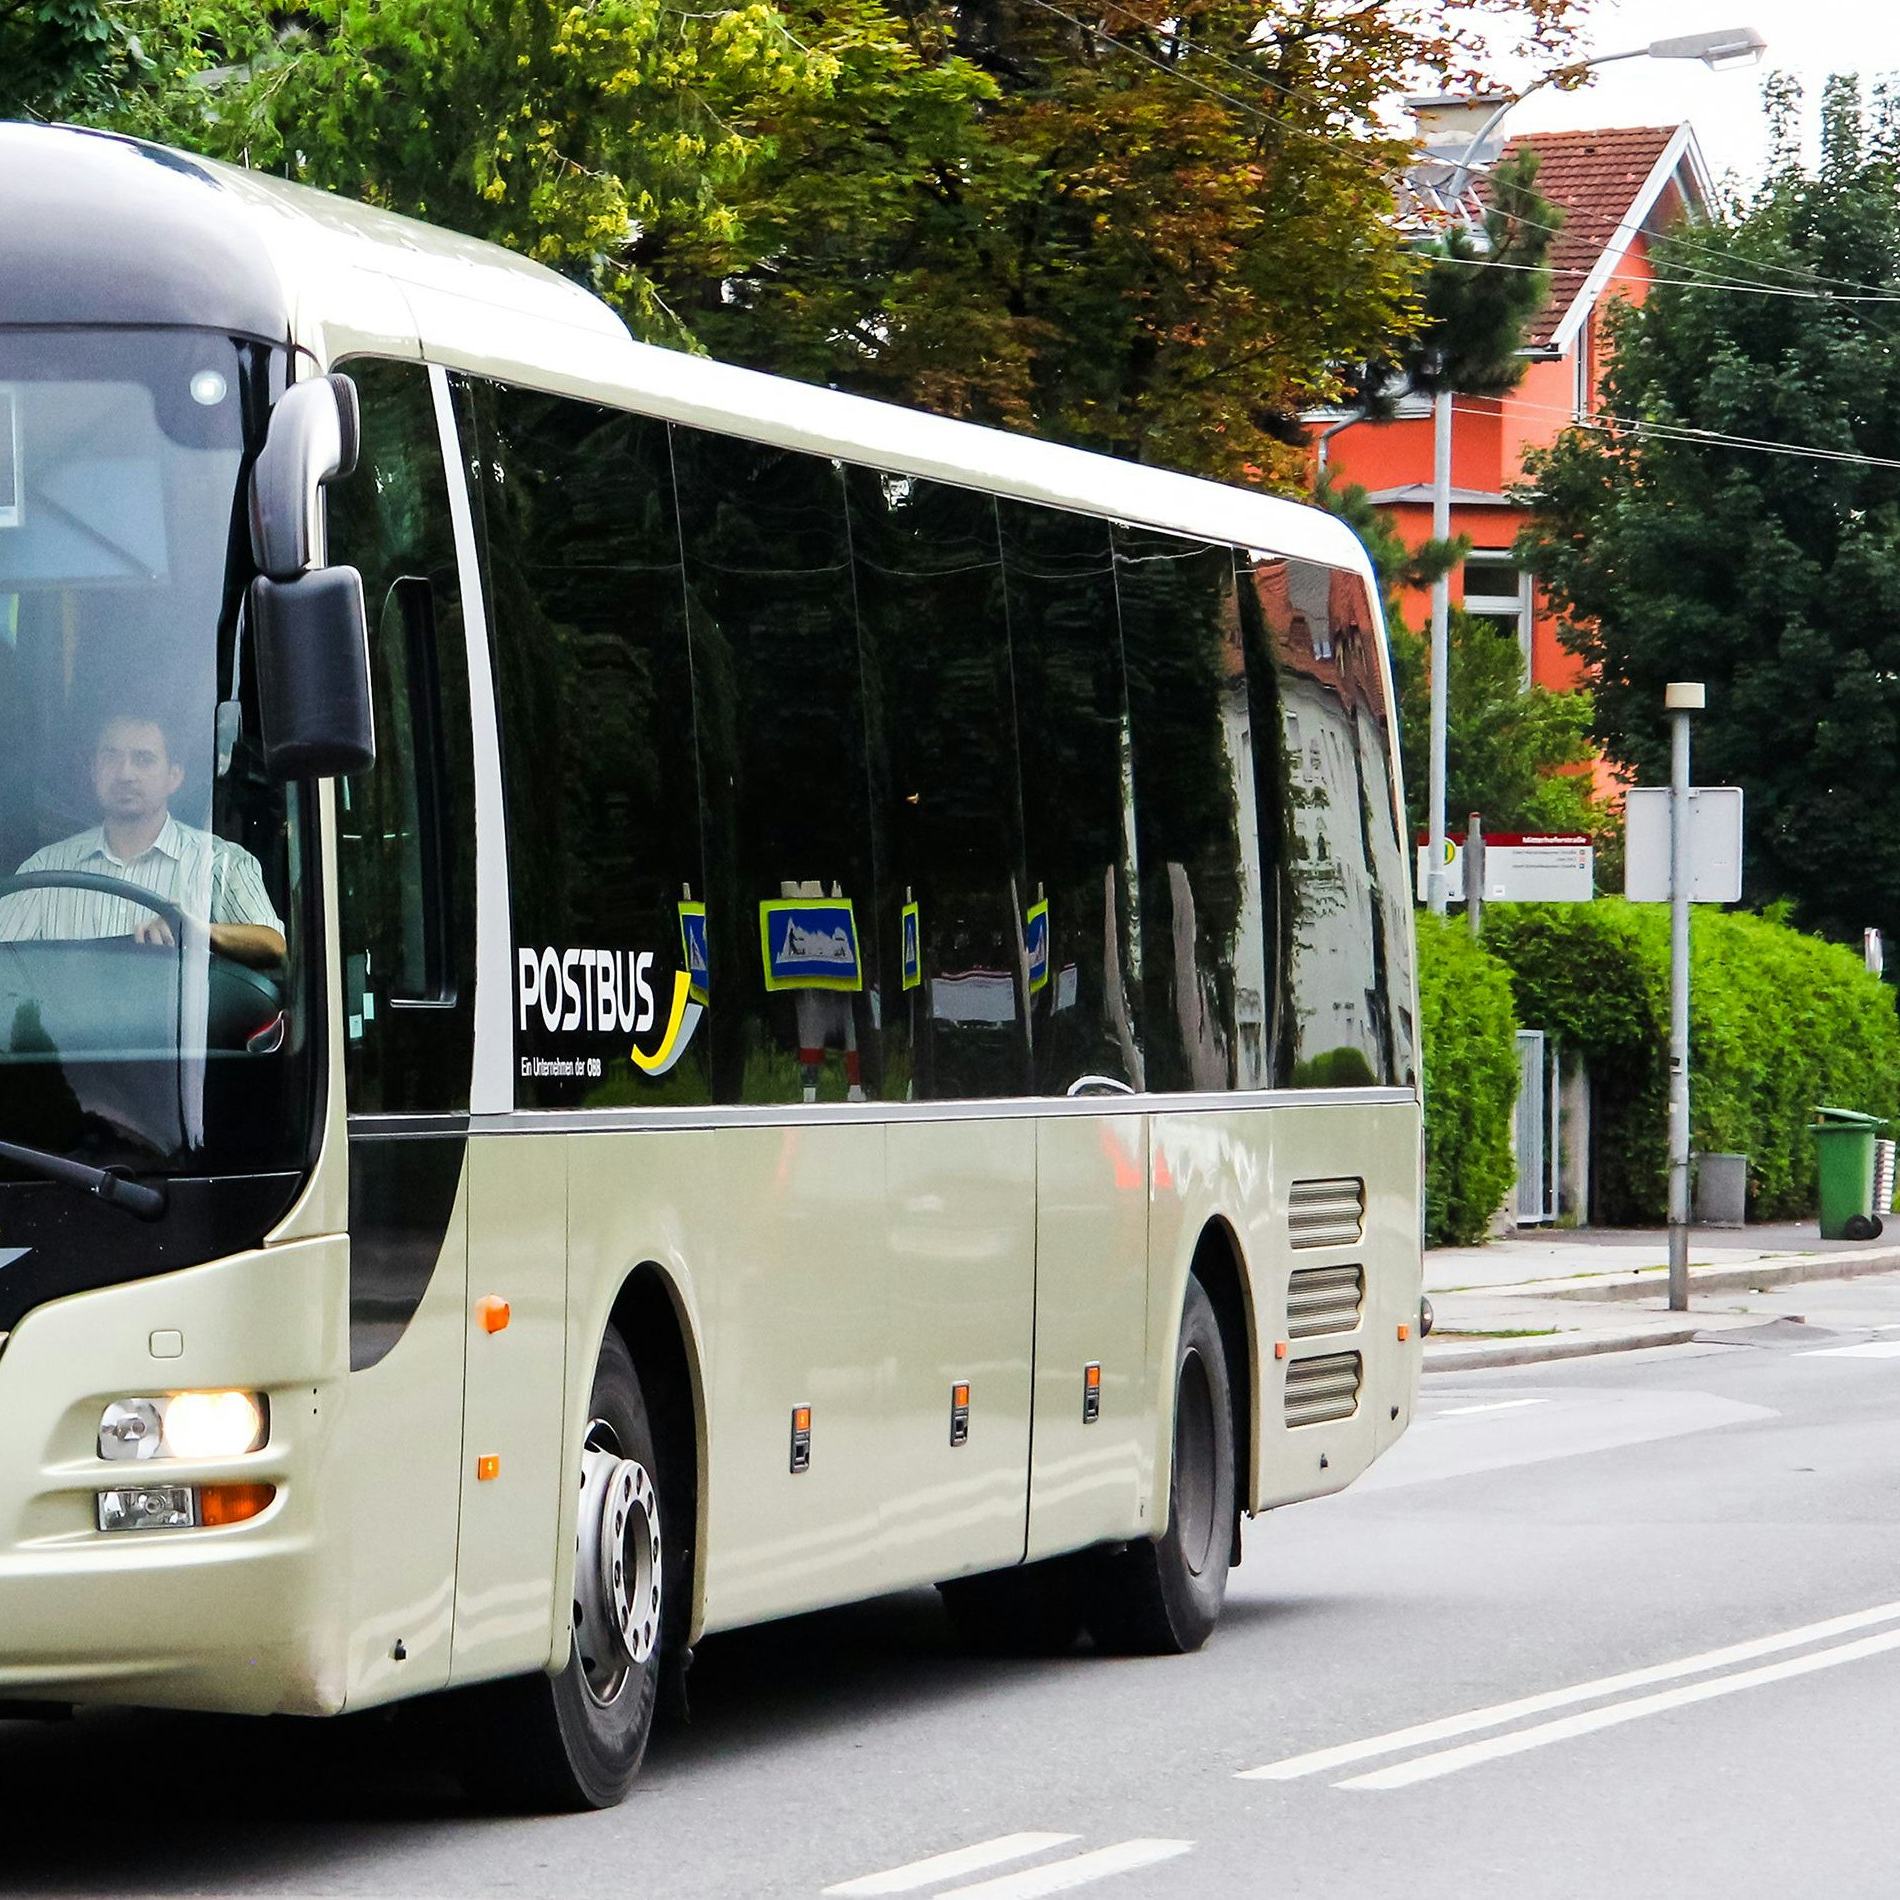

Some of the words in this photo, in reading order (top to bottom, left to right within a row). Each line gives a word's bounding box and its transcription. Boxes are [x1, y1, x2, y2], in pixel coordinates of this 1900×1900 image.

[518, 945, 654, 1033] POSTBUS
[521, 1056, 532, 1077] Ein
[533, 1056, 574, 1077] Unternehmen
[575, 1056, 586, 1077] der
